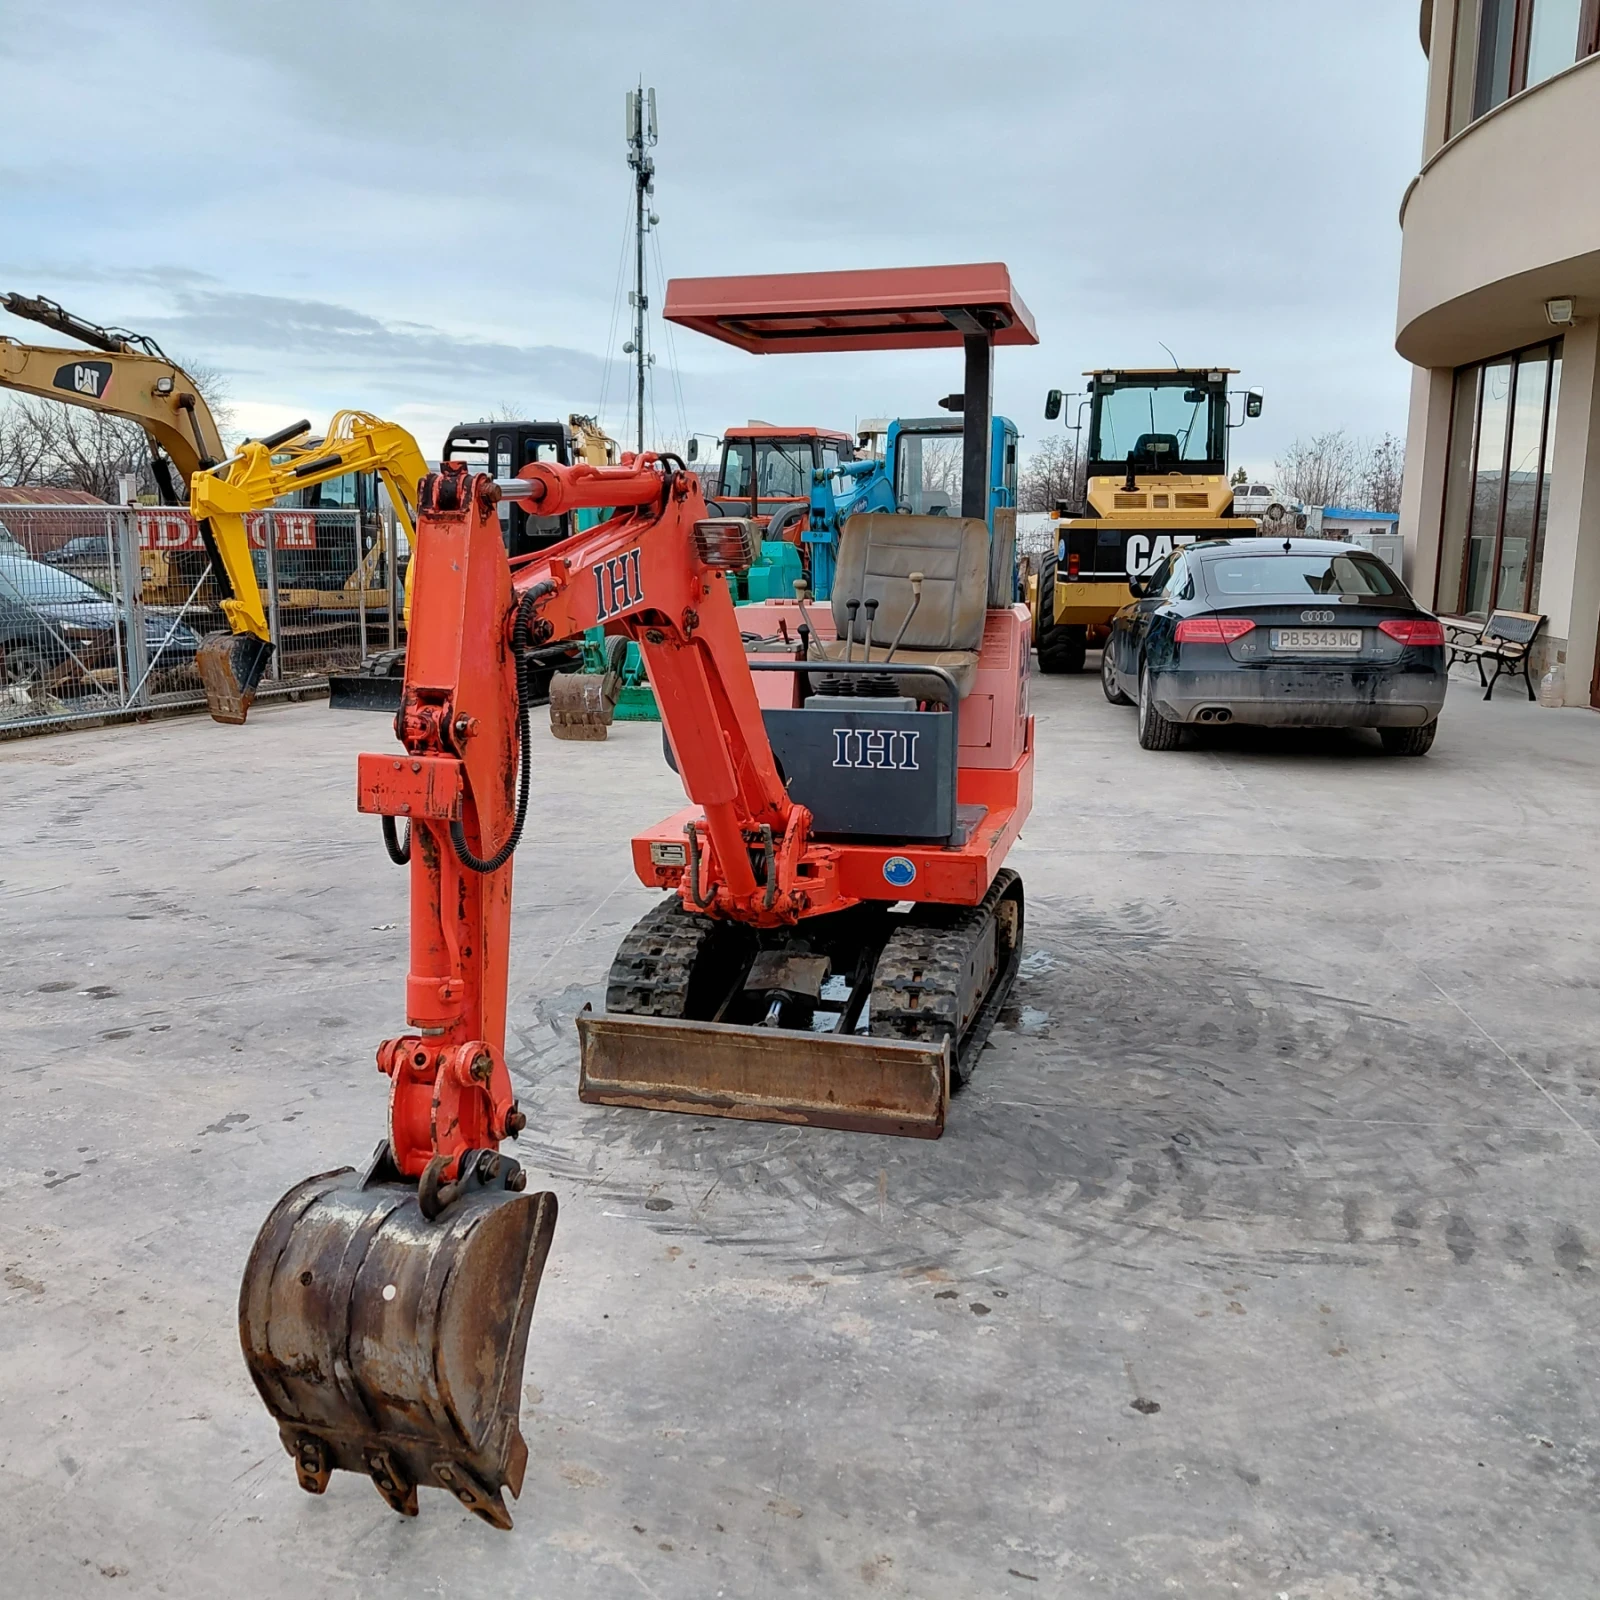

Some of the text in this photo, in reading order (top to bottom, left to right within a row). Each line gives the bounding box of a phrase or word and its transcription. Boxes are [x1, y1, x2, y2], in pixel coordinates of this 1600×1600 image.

[74, 365, 99, 395] CAT
[592, 546, 644, 623] IHI
[1280, 631, 1299, 646] PB
[1302, 632, 1337, 646] 5343
[1339, 633, 1358, 647] MC
[832, 728, 920, 770] IHI
